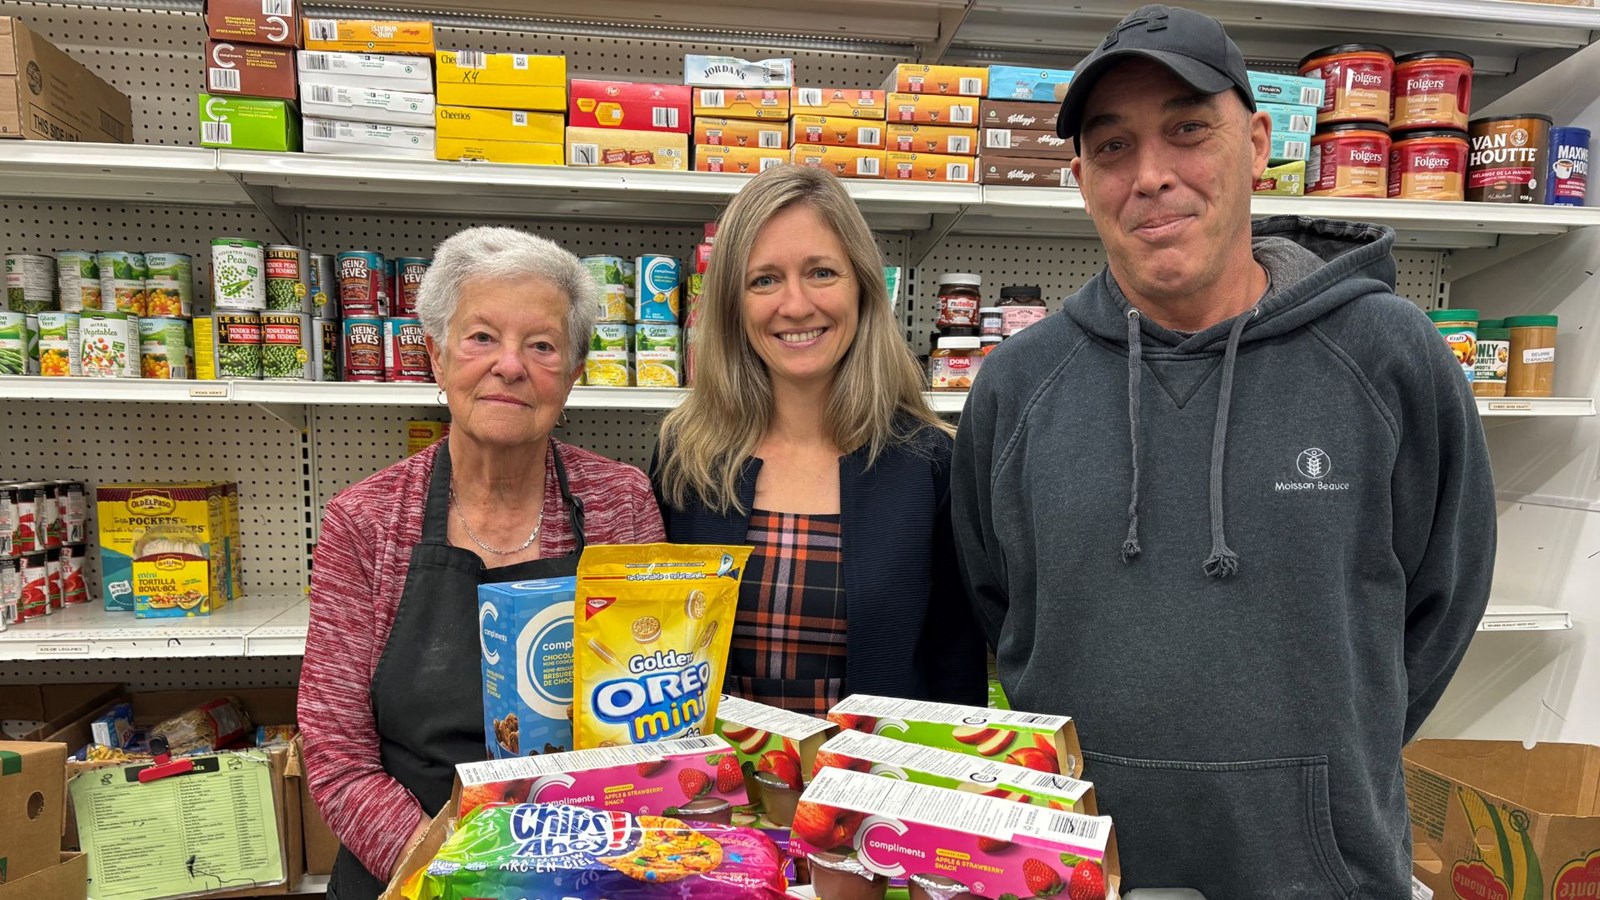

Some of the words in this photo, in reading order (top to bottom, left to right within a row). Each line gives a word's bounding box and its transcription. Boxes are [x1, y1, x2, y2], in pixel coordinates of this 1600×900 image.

[704, 65, 747, 80] JORDANS
[1352, 72, 1382, 86] Folgers
[1407, 78, 1445, 91] Folgers
[441, 110, 471, 120] Cheerios
[1007, 113, 1036, 126] Kellogg's
[1472, 133, 1506, 151] VAN
[1350, 149, 1382, 164] Folgers
[1470, 148, 1537, 167] HOUTTE
[1414, 156, 1450, 169] Folgers
[1007, 168, 1036, 181] Kellogg's
[227, 254, 248, 265] Peas
[270, 250, 298, 260] SIEUR
[342, 259, 364, 269] HEINZ
[342, 268, 368, 279] FEVES
[950, 300, 974, 308] nutella
[234, 316, 260, 325] SIEU
[270, 316, 299, 325] SIEUR
[83, 327, 118, 338] Vegetables
[352, 326, 376, 336] HEINZ
[350, 335, 379, 345] FEVES
[949, 358, 970, 366] DORA
[1275, 481, 1315, 492] Moisson
[1317, 482, 1350, 491] Beauce
[131, 498, 145, 508] OLD
[145, 497, 154, 506] EL
[130, 517, 178, 525] POCKETS
[138, 571, 157, 579] mini
[629, 650, 695, 675] Golden
[596, 662, 710, 718] OREO
[634, 690, 705, 741] mini
[605, 792, 622, 800] APPLE
[627, 787, 664, 798] STRAWBERRY
[605, 798, 625, 807] SNACK
[512, 803, 611, 842] Chips
[869, 839, 926, 859] compliments
[563, 855, 595, 869] CIEL
[934, 862, 958, 872] SNACK
[935, 856, 956, 865] APPLE
[961, 861, 1005, 875] STRAWBERRY
